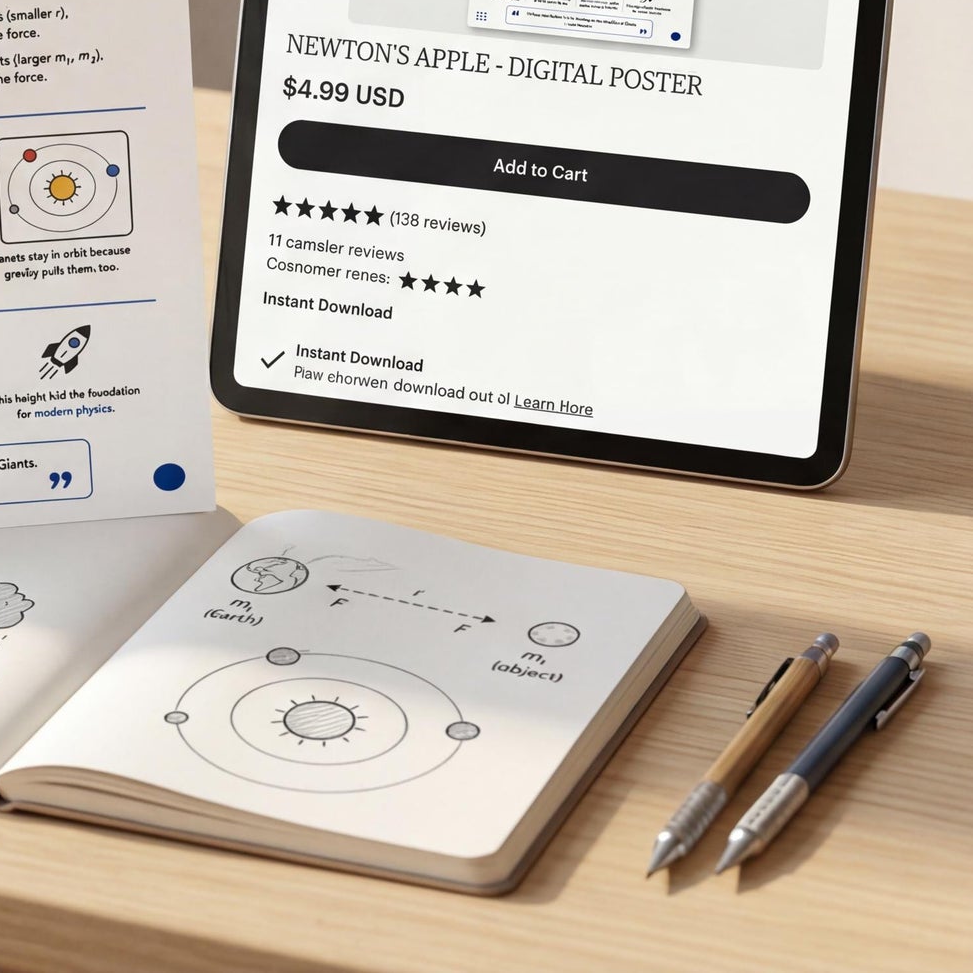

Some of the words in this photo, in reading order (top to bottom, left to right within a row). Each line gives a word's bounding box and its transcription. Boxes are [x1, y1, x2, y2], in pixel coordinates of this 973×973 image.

[6, 8, 53, 23] (smaller
[286, 33, 410, 66] NEWTON'S
[413, 47, 490, 74] APPLE
[507, 56, 604, 86] DIGITAL
[608, 66, 703, 96] POSTER
[282, 75, 349, 103] $4.99
[356, 84, 405, 108] USD
[493, 158, 527, 176] Add
[531, 163, 548, 178] to
[552, 165, 588, 183] Cart
[389, 210, 420, 228] (138
[423, 217, 486, 238] reviews)
[28, 252, 49, 264] stay
[51, 249, 61, 259] in
[63, 247, 88, 259] orbit
[89, 246, 131, 257] because
[269, 233, 282, 247] 11
[348, 245, 405, 262] reviews
[263, 291, 315, 310] Instant
[318, 298, 393, 320] Download
[296, 343, 347, 363] Instant
[350, 350, 424, 373] Download
[393, 378, 466, 400] download
[468, 390, 494, 404] out
[515, 394, 555, 412] Learn
[16, 408, 32, 419] for
[34, 406, 74, 418] modern
[75, 403, 116, 418] physics.
